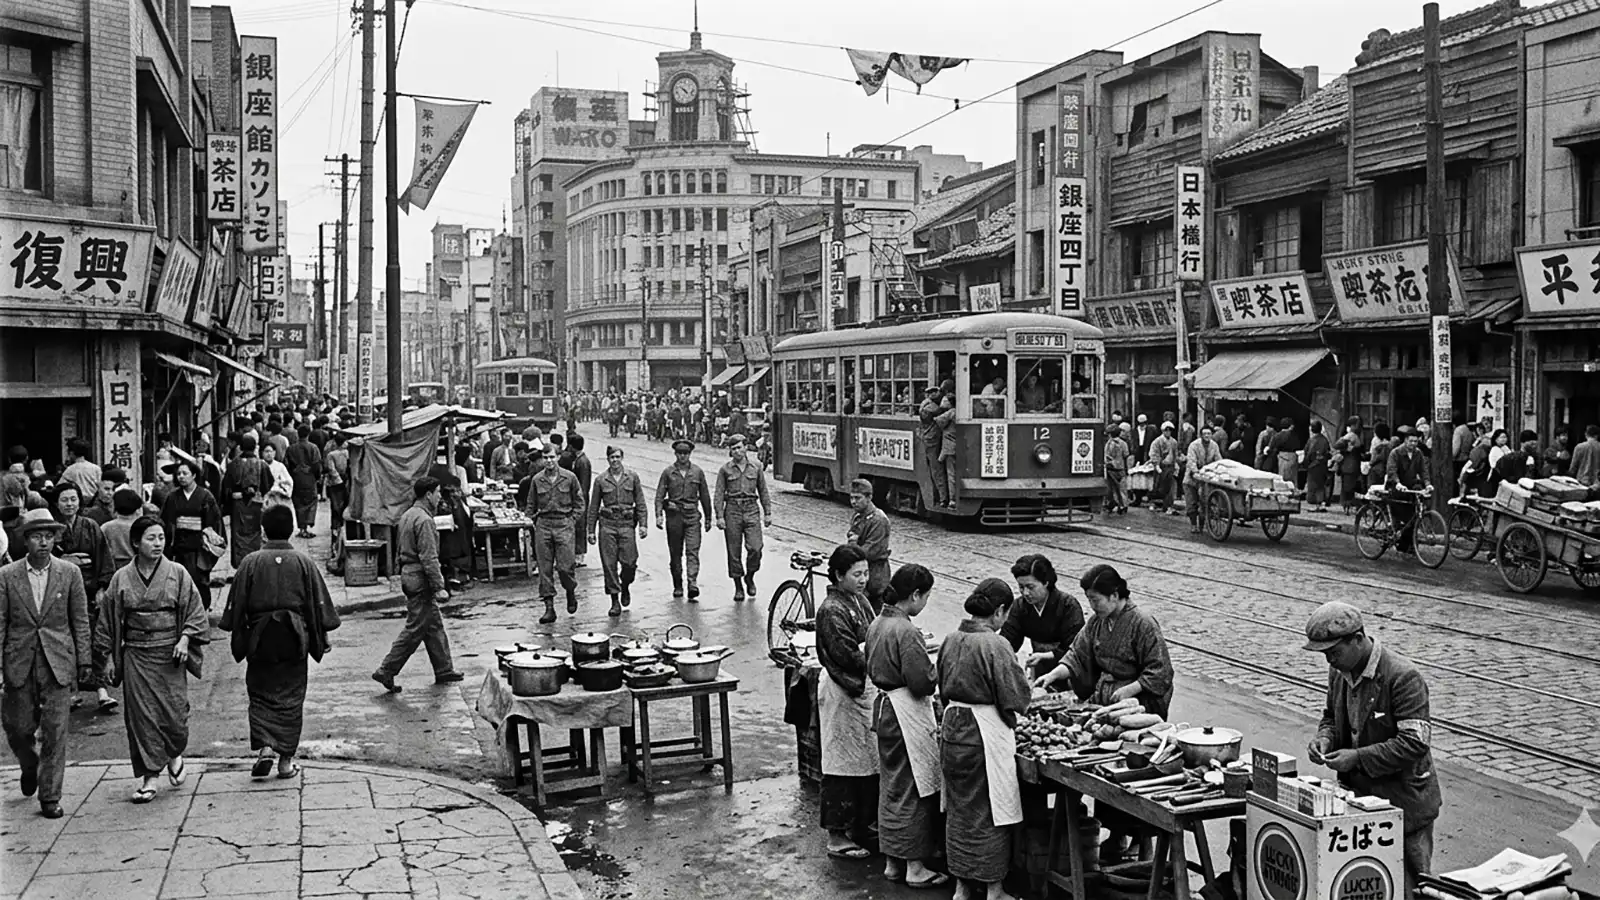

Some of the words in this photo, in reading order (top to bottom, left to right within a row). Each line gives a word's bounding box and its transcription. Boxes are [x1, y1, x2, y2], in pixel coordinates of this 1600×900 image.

[10, 230, 129, 295] 復興
[1058, 183, 1083, 311] 銀座四丁目
[1229, 281, 1305, 319] 喫茶店
[1541, 251, 1600, 306] 平
[1033, 427, 1050, 440] 12
[1328, 821, 1395, 853] たばこ
